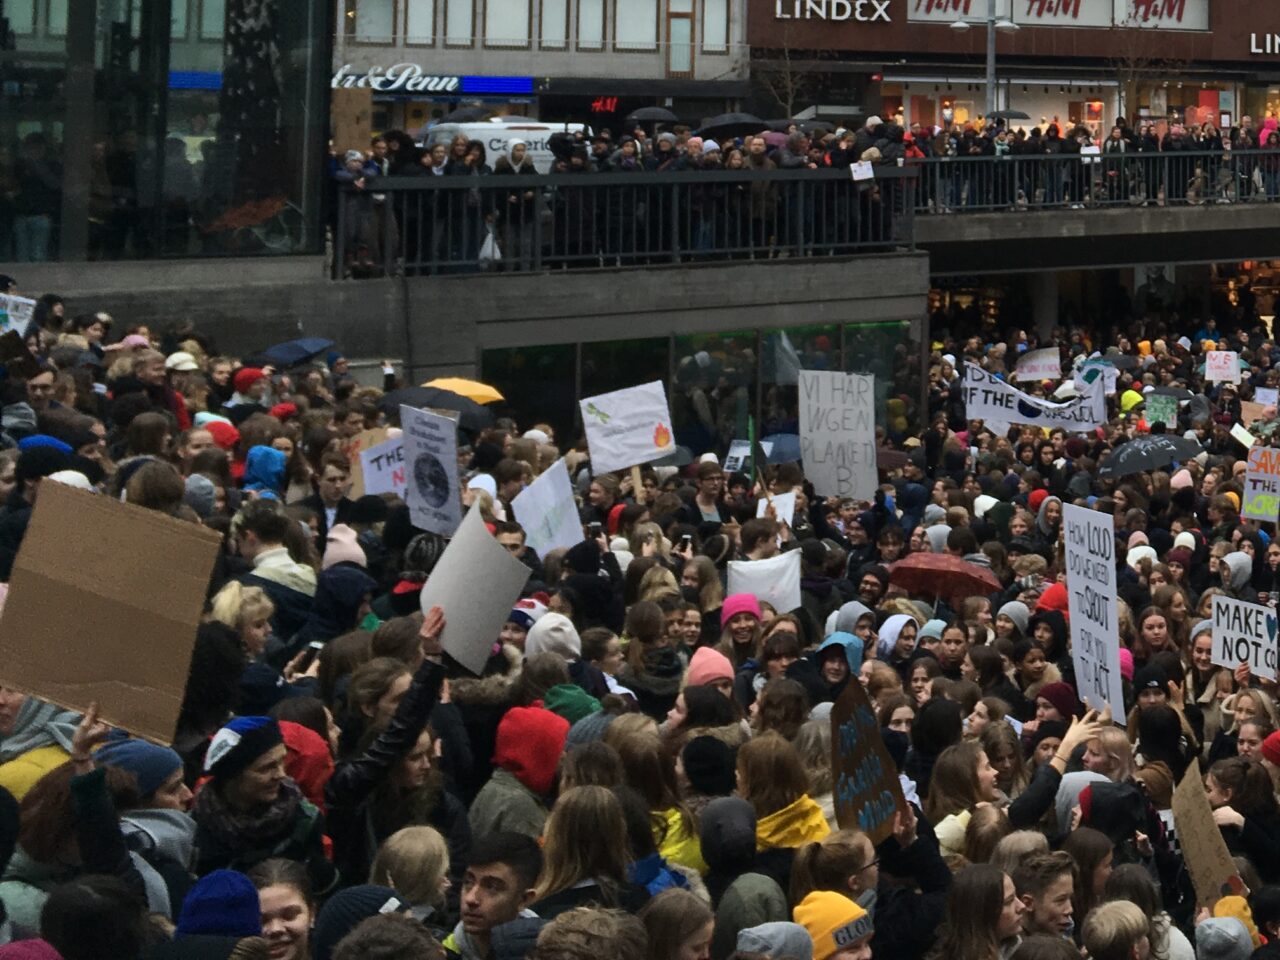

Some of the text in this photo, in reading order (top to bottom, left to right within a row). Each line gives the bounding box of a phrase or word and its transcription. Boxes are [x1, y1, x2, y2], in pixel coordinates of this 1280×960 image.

[591, 96, 618, 113] H&M
[802, 374, 868, 407] VI HAR
[981, 389, 1015, 410] THE
[370, 446, 405, 471] THE
[836, 466, 855, 495] B
[1249, 478, 1277, 493] THE
[1068, 520, 1112, 561] HOW LOUD
[1085, 585, 1110, 631] SHOUT
[1216, 601, 1264, 639] MAKE
[1222, 636, 1262, 668] NOT
[1094, 662, 1111, 703] ACT
